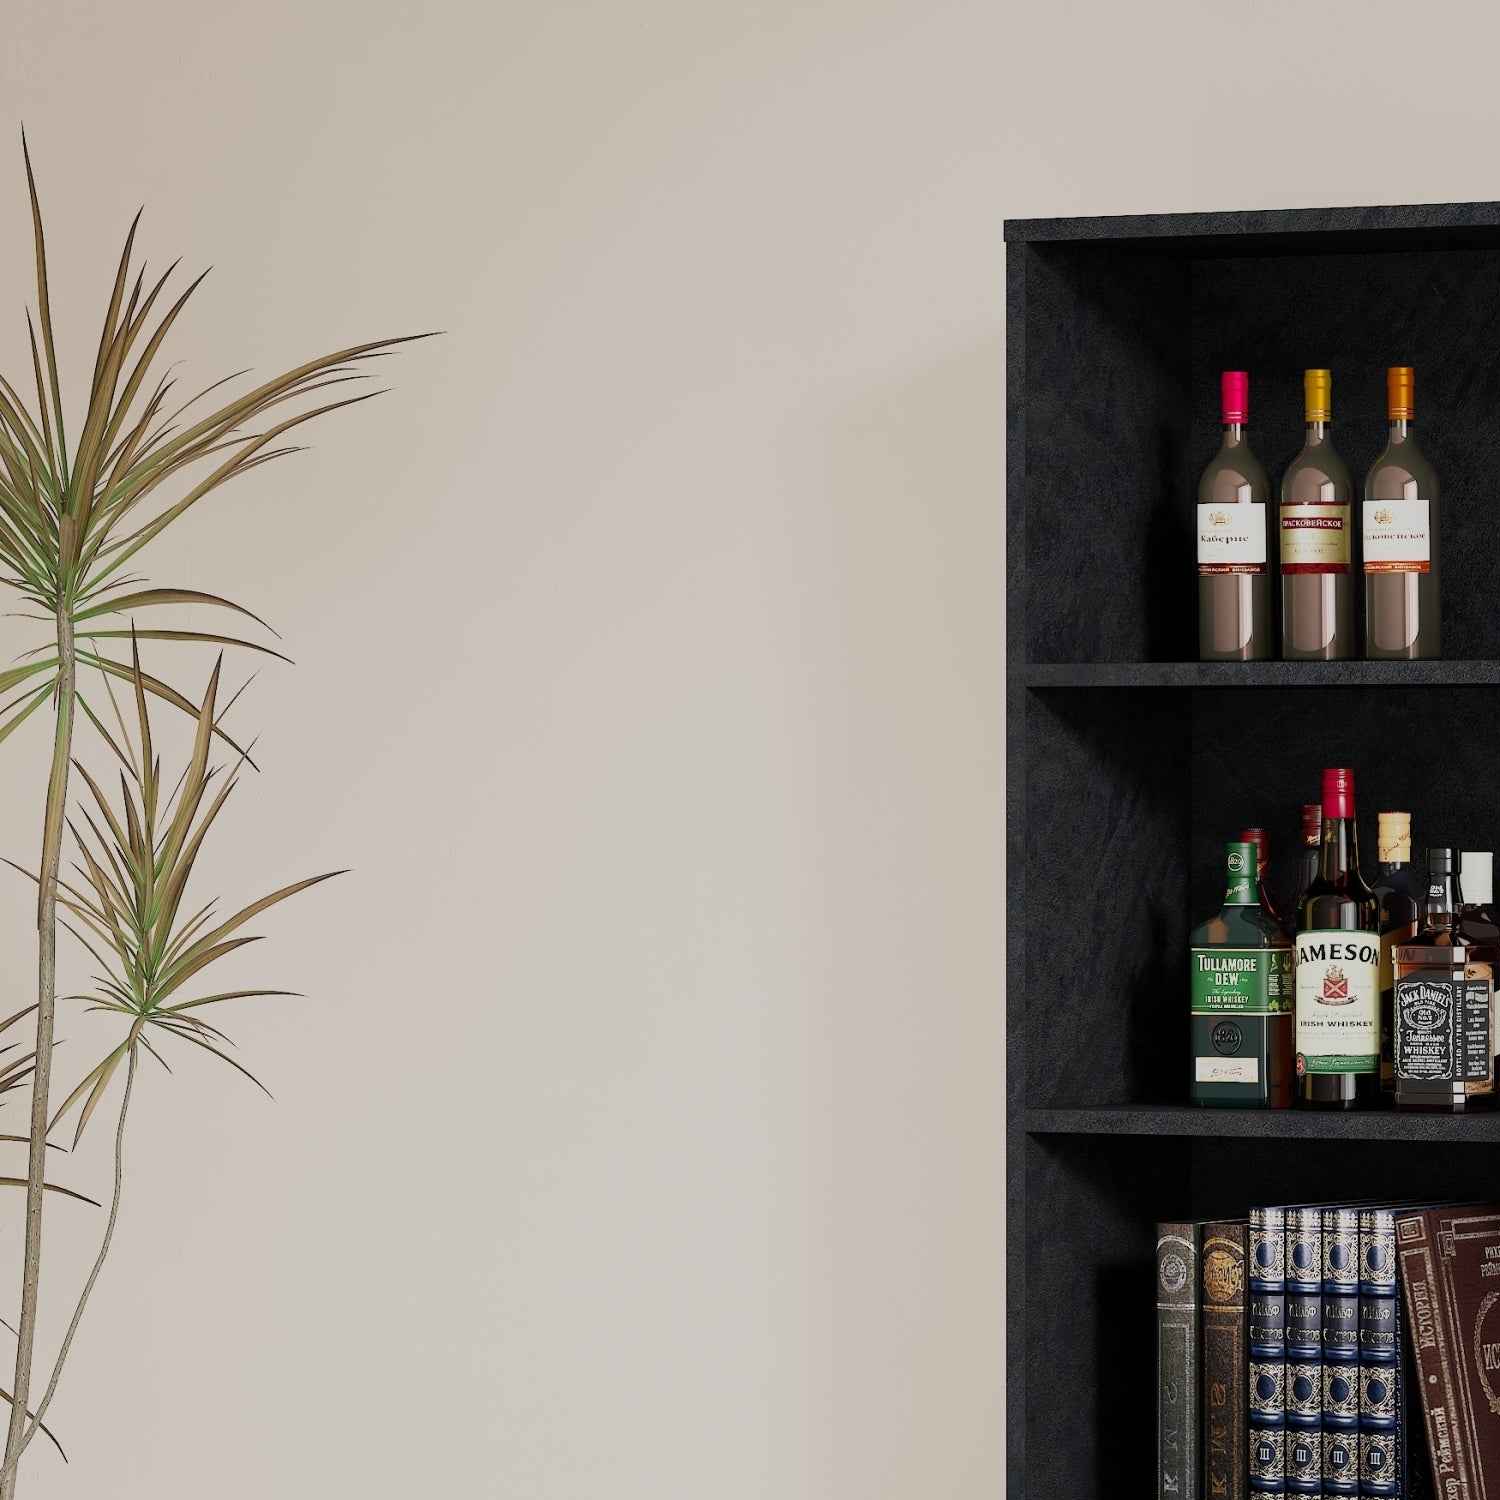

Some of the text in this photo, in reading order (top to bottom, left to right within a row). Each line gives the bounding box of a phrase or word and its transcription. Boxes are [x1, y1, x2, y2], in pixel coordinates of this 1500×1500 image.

[1197, 954, 1257, 972] TULLAMORE
[1215, 973, 1240, 985] DEW
[1404, 1046, 1447, 1055] WHISKEY
